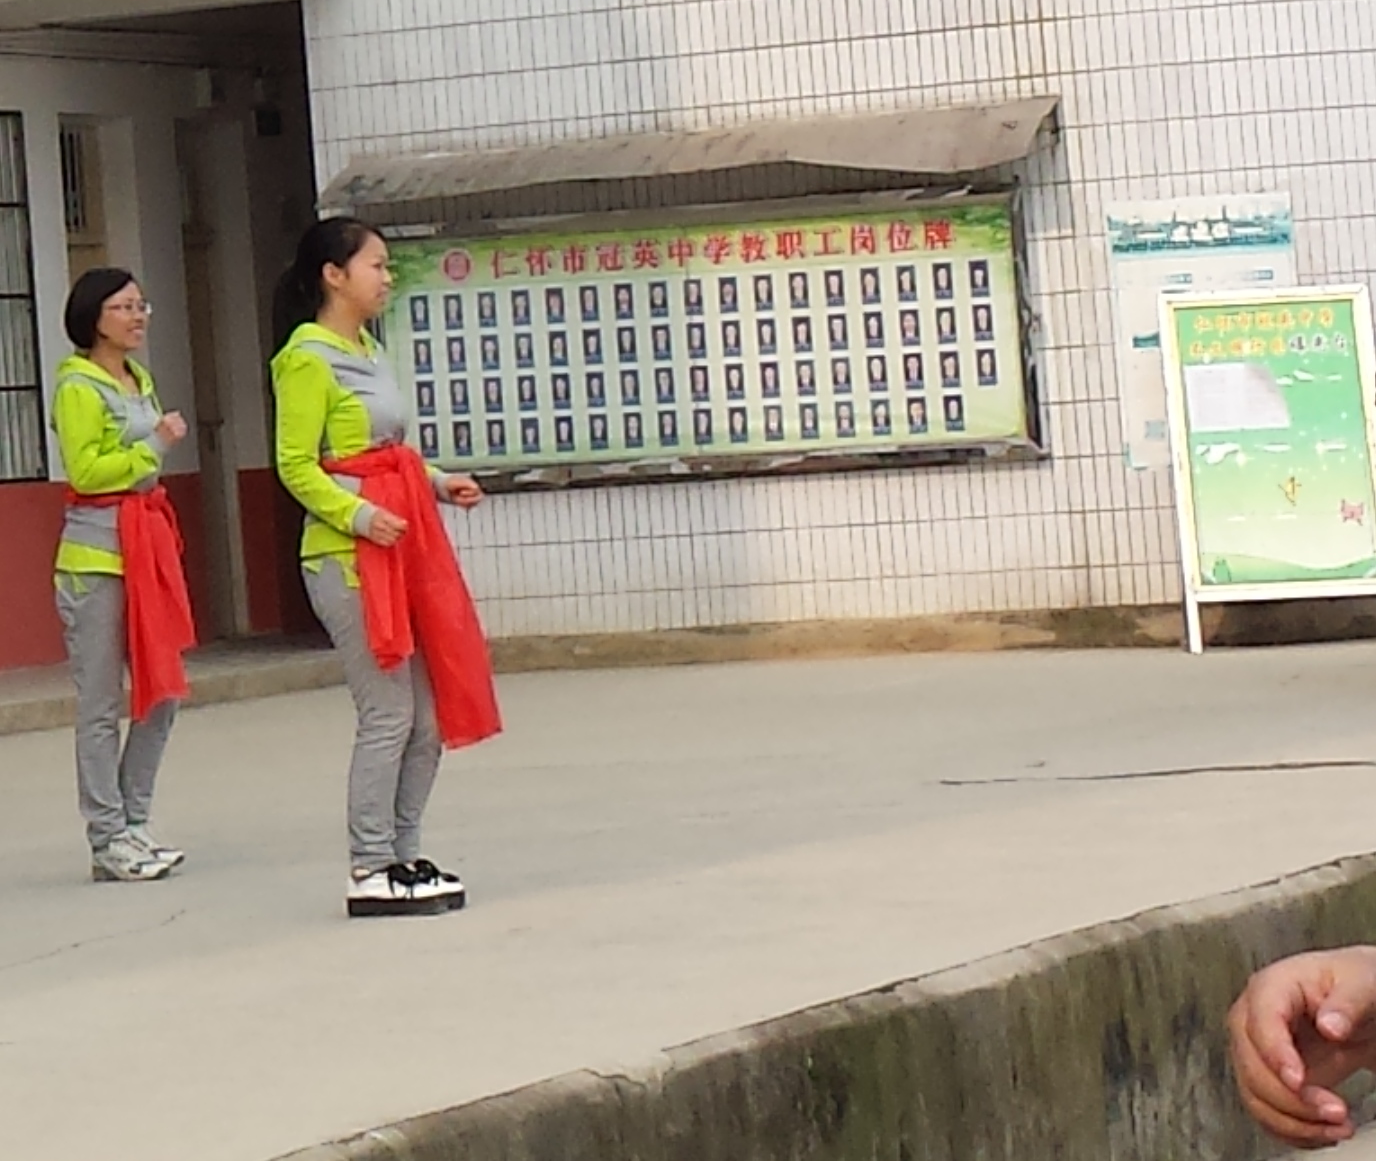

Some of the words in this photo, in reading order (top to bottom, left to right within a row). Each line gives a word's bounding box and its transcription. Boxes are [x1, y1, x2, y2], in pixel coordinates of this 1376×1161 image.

[490, 220, 957, 280] 仁怀市冠英中学教职工岗位牌
